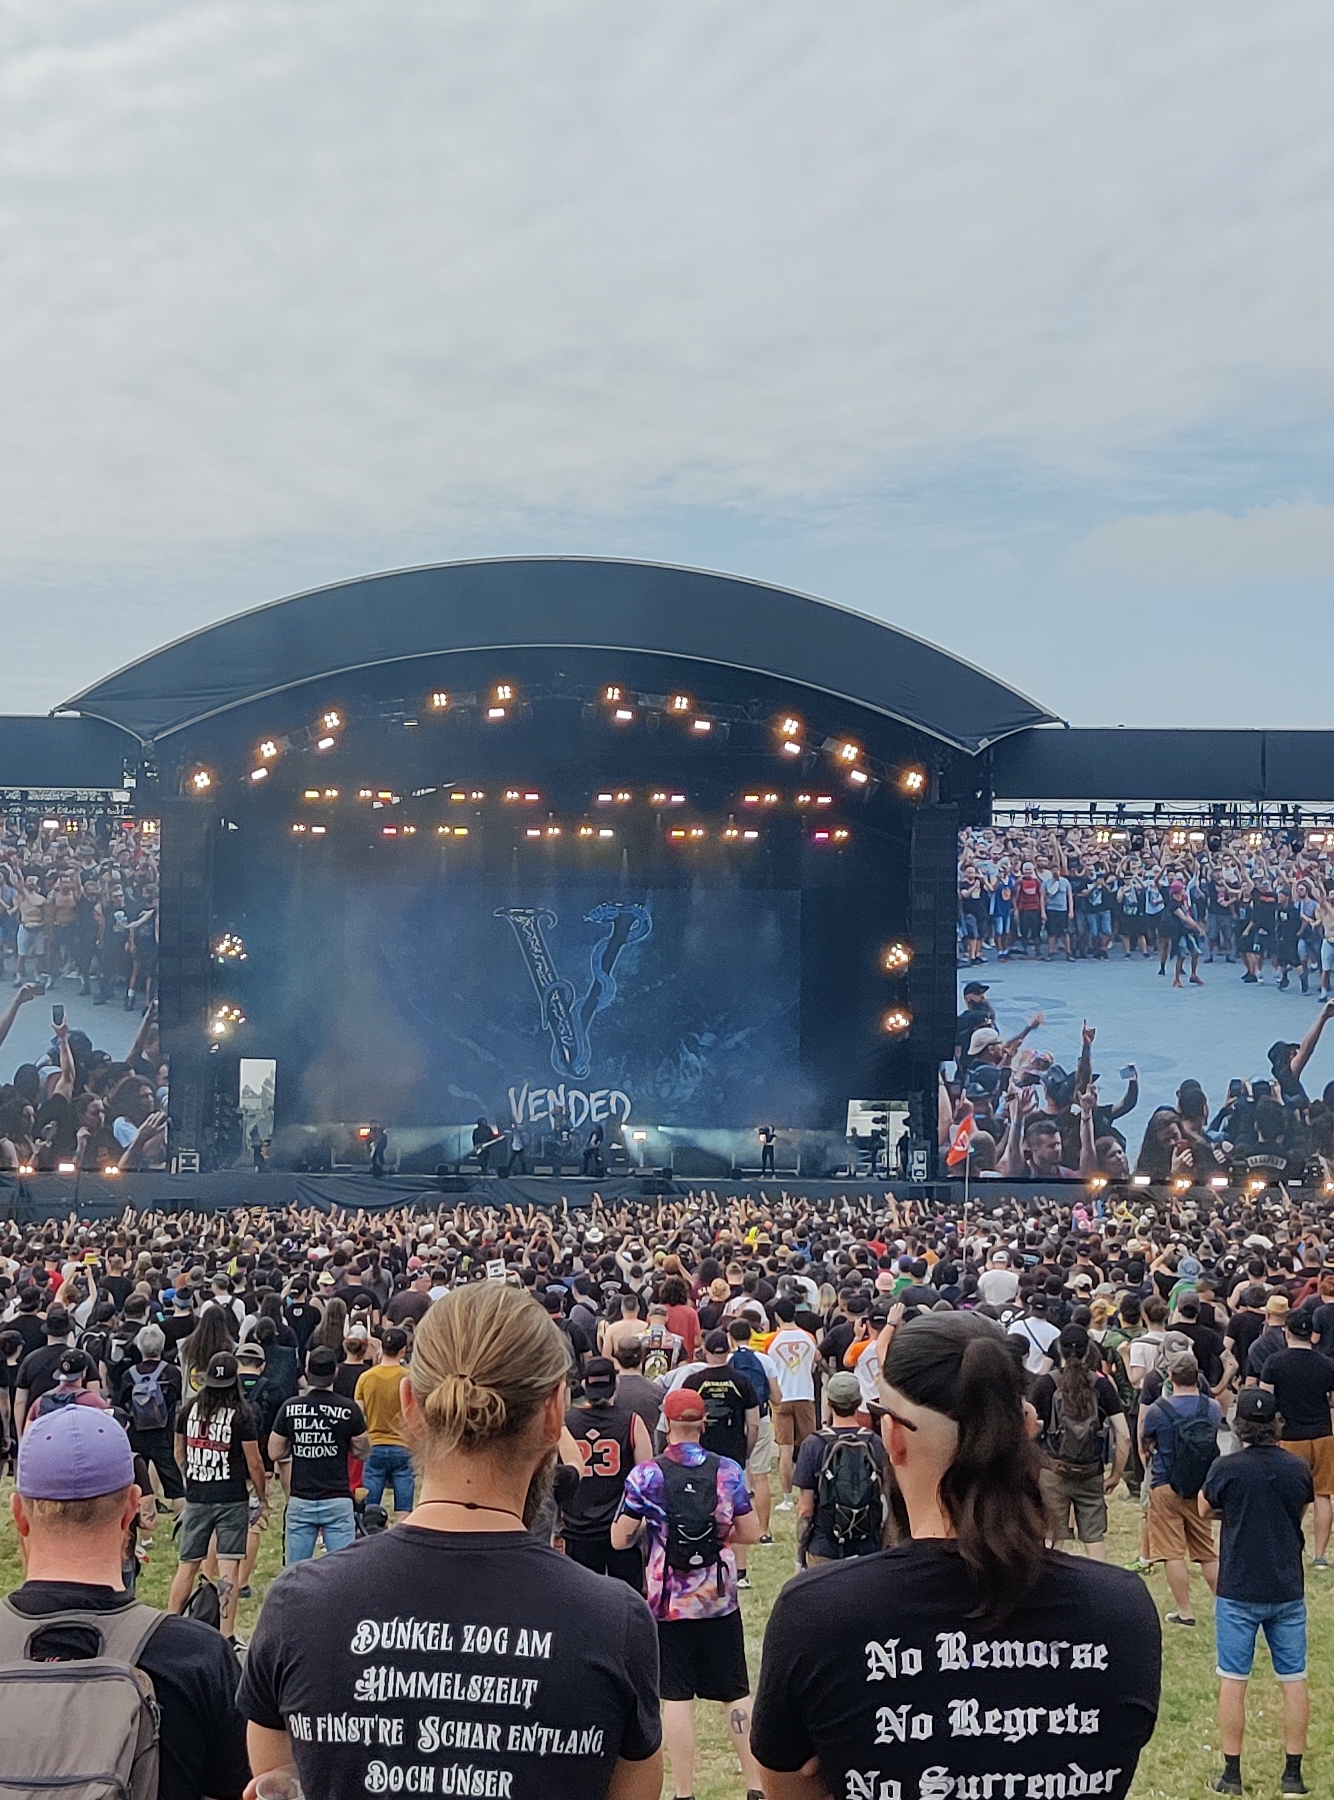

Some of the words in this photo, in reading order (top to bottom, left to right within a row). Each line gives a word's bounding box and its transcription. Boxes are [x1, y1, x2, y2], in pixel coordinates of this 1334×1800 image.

[508, 1082, 632, 1129] VENDED
[188, 1402, 236, 1425] ARY
[286, 1403, 352, 1420] HELLENIC
[187, 1420, 232, 1444] MUSIC
[294, 1432, 335, 1444] METAL
[187, 1445, 229, 1468] HAPPY
[293, 1444, 338, 1458] LEGIONS
[187, 1463, 231, 1482] PEOPLE
[865, 1638, 923, 1681] No
[935, 1631, 1109, 1671] Remorse
[874, 1704, 933, 1744] No
[948, 1698, 1100, 1743] Regrets
[845, 1769, 902, 1800] No
[918, 1763, 1122, 1800] Surrender
